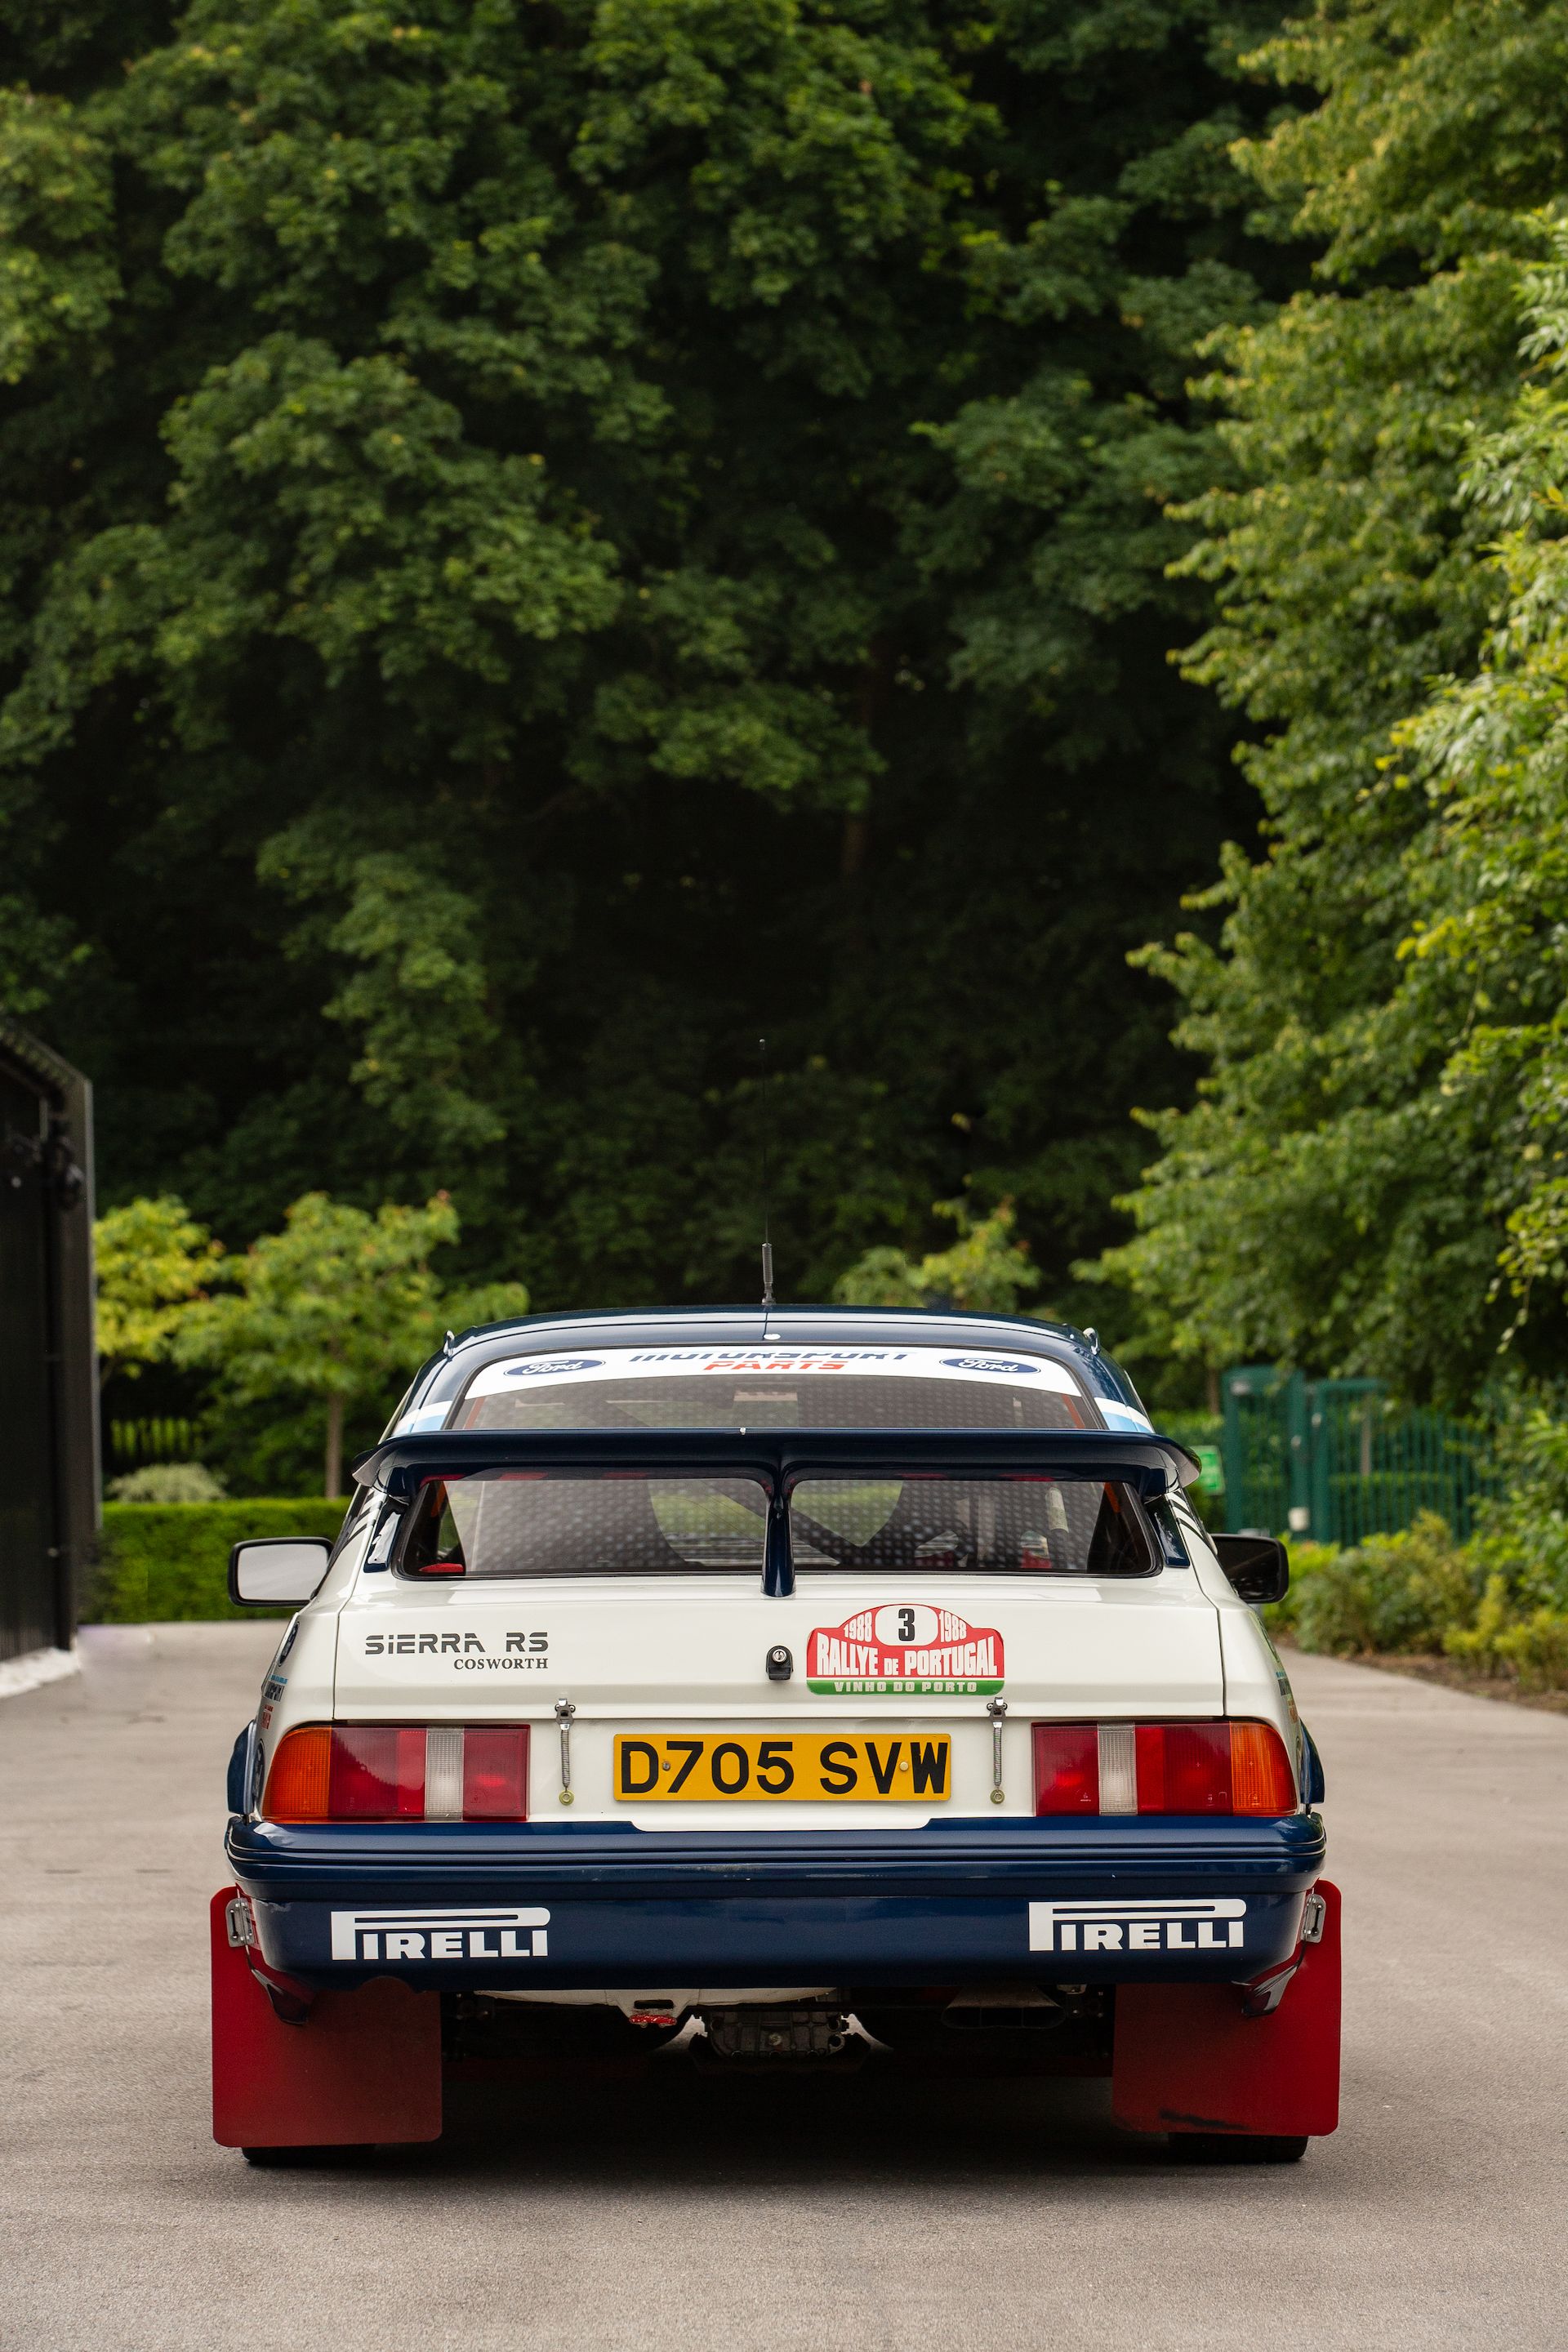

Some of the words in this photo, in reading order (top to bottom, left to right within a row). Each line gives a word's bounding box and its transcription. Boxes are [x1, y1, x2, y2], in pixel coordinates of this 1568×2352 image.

[628, 1351, 915, 1362] MOTORSPORT
[703, 1361, 849, 1370] PARTS
[843, 1611, 873, 1643] 1988
[898, 1608, 915, 1642] 3
[938, 1610, 967, 1643] 1988
[506, 1632, 549, 1653] RS
[817, 1632, 879, 1676] RALLYE
[884, 1657, 899, 1676] DE
[904, 1636, 997, 1677] PORTUGAL
[453, 1657, 549, 1670] COSWORTH
[833, 1681, 887, 1692] VINHO
[893, 1681, 916, 1692] DO
[921, 1681, 978, 1692] PORTO
[621, 1740, 795, 1794] D705
[819, 1740, 949, 1794] SVW
[330, 1907, 551, 1961] PIRELLI
[1028, 1899, 1247, 1952] PIRELLI
